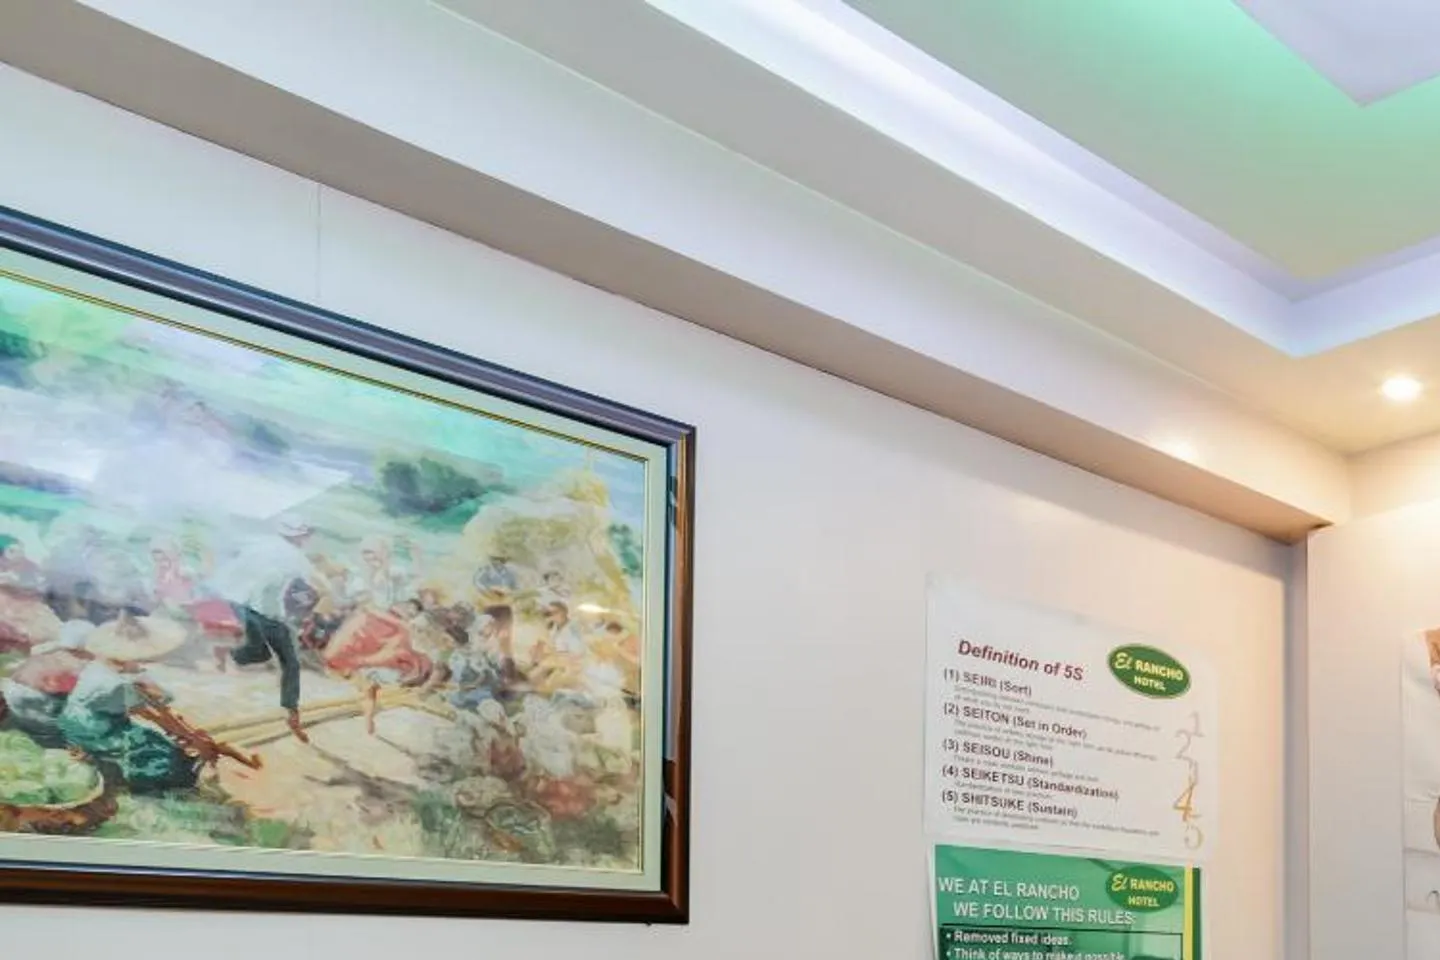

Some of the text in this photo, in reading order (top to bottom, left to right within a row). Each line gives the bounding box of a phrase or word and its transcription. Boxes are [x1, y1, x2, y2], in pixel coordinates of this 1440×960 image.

[958, 640, 1083, 681] Definition of 5S
[1135, 659, 1184, 680] RANCHO
[944, 668, 960, 683] (1)
[1134, 675, 1166, 692] HOTEL
[944, 702, 959, 716] (2)
[963, 706, 1009, 725] SEITON
[1038, 722, 1049, 732] in
[1051, 723, 1088, 740] Order)
[943, 738, 959, 752] (3)
[963, 741, 1010, 759] SEISOU
[942, 764, 959, 778] (4)
[942, 788, 959, 803] (5)
[938, 877, 1080, 900] WE AT EL RANCHO
[1112, 872, 1175, 893] El RANCHO
[1128, 895, 1160, 907] HOTEL
[953, 900, 980, 917] WE
[983, 903, 1048, 920] FOLLOW
[1052, 906, 1084, 922] THIS
[954, 930, 1009, 943] Removed
[954, 948, 985, 960] Think
[988, 949, 1000, 960] of
[1032, 950, 1043, 960] to
